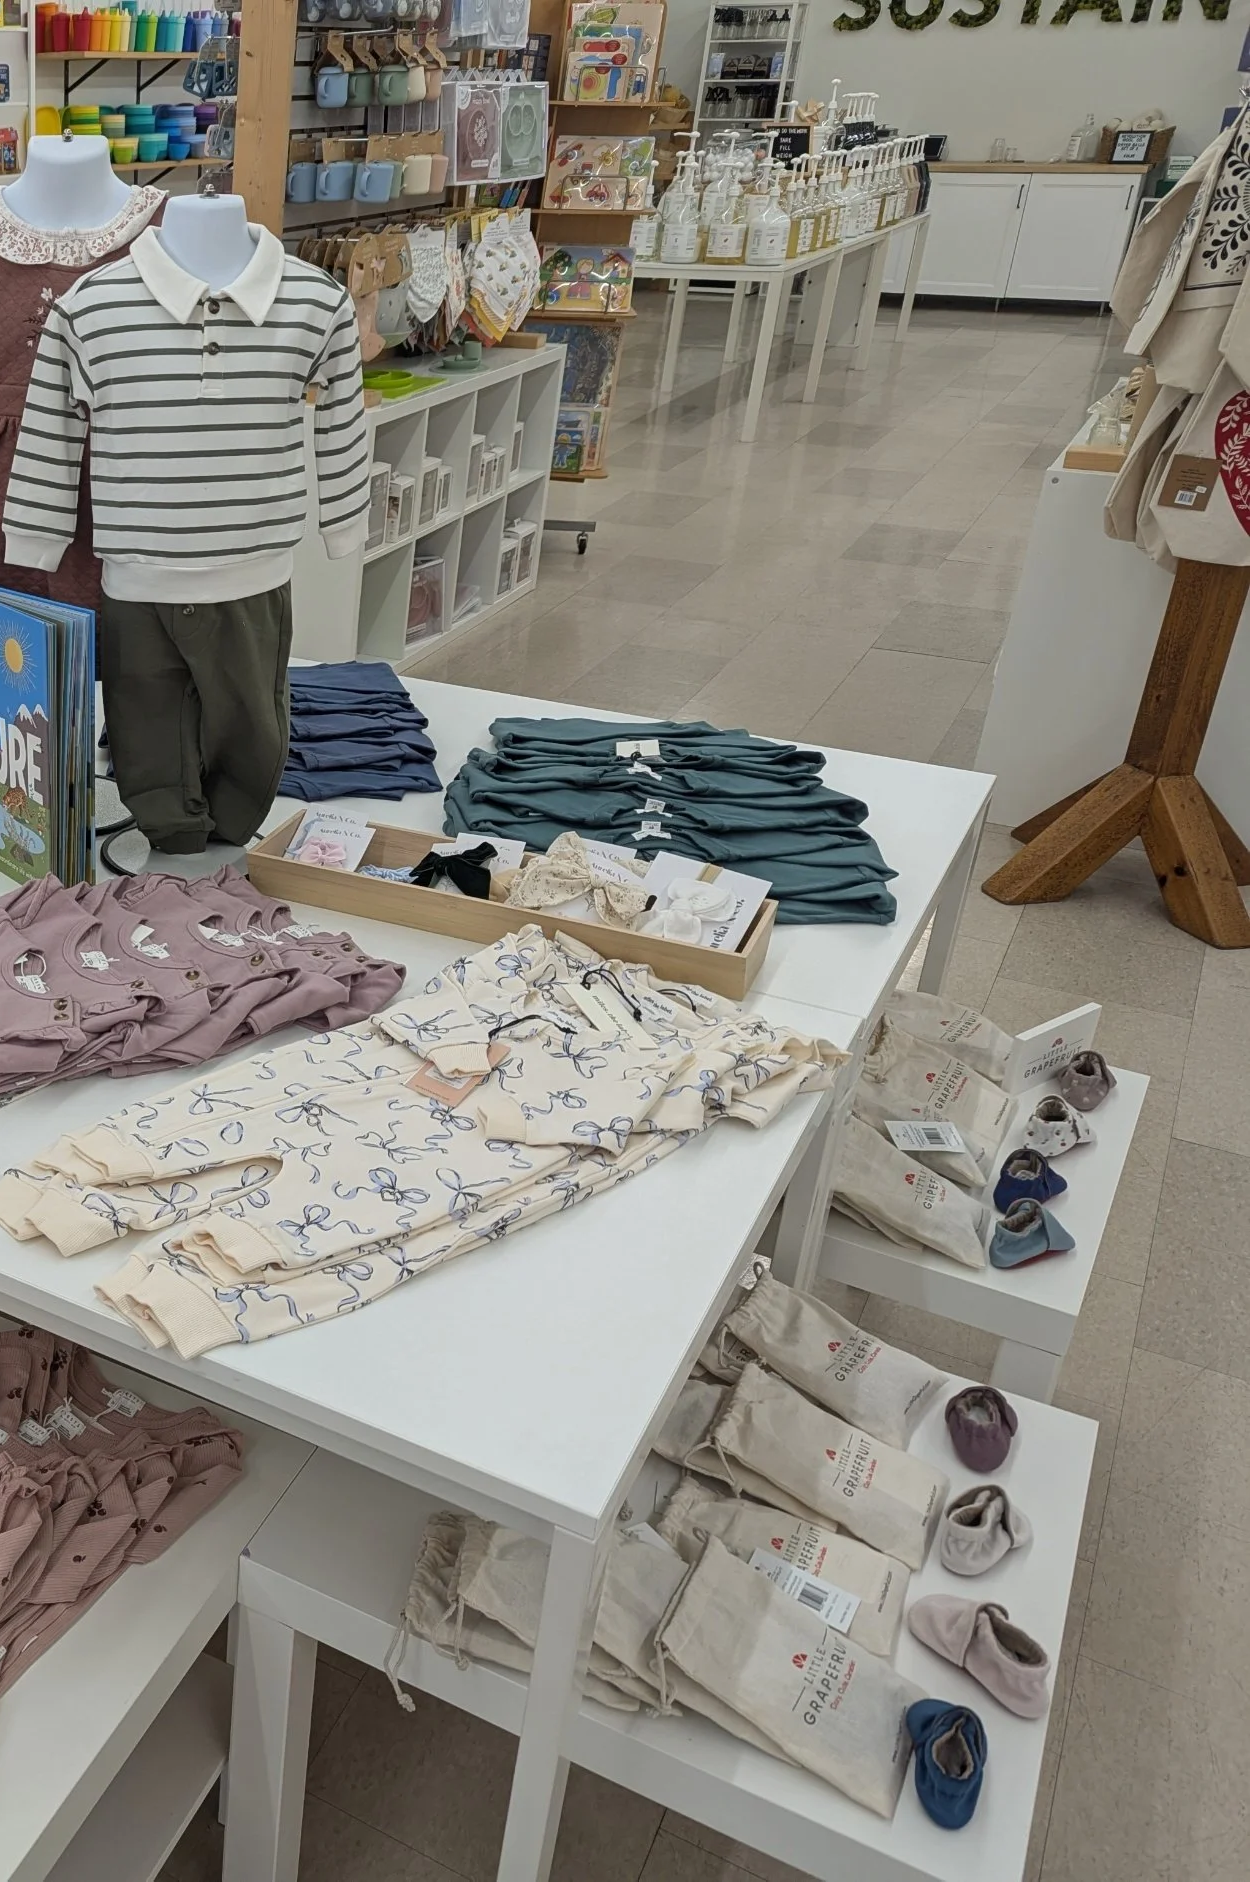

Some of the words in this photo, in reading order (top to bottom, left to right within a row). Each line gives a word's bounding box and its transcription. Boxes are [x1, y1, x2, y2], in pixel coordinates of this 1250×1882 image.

[1024, 1046, 1082, 1078] GRAPEFRUIT
[1043, 1044, 1068, 1060] LITTLE
[933, 1068, 949, 1091] LITTLE
[934, 1061, 966, 1110] GRAPEFRUIT
[834, 1335, 858, 1364] LITTLE
[837, 1448, 851, 1473] LITTLE
[843, 1438, 872, 1498] GRAPEFRUIT
[796, 1527, 822, 1571] APEFRUIT
[803, 1647, 826, 1684] LITTLE
